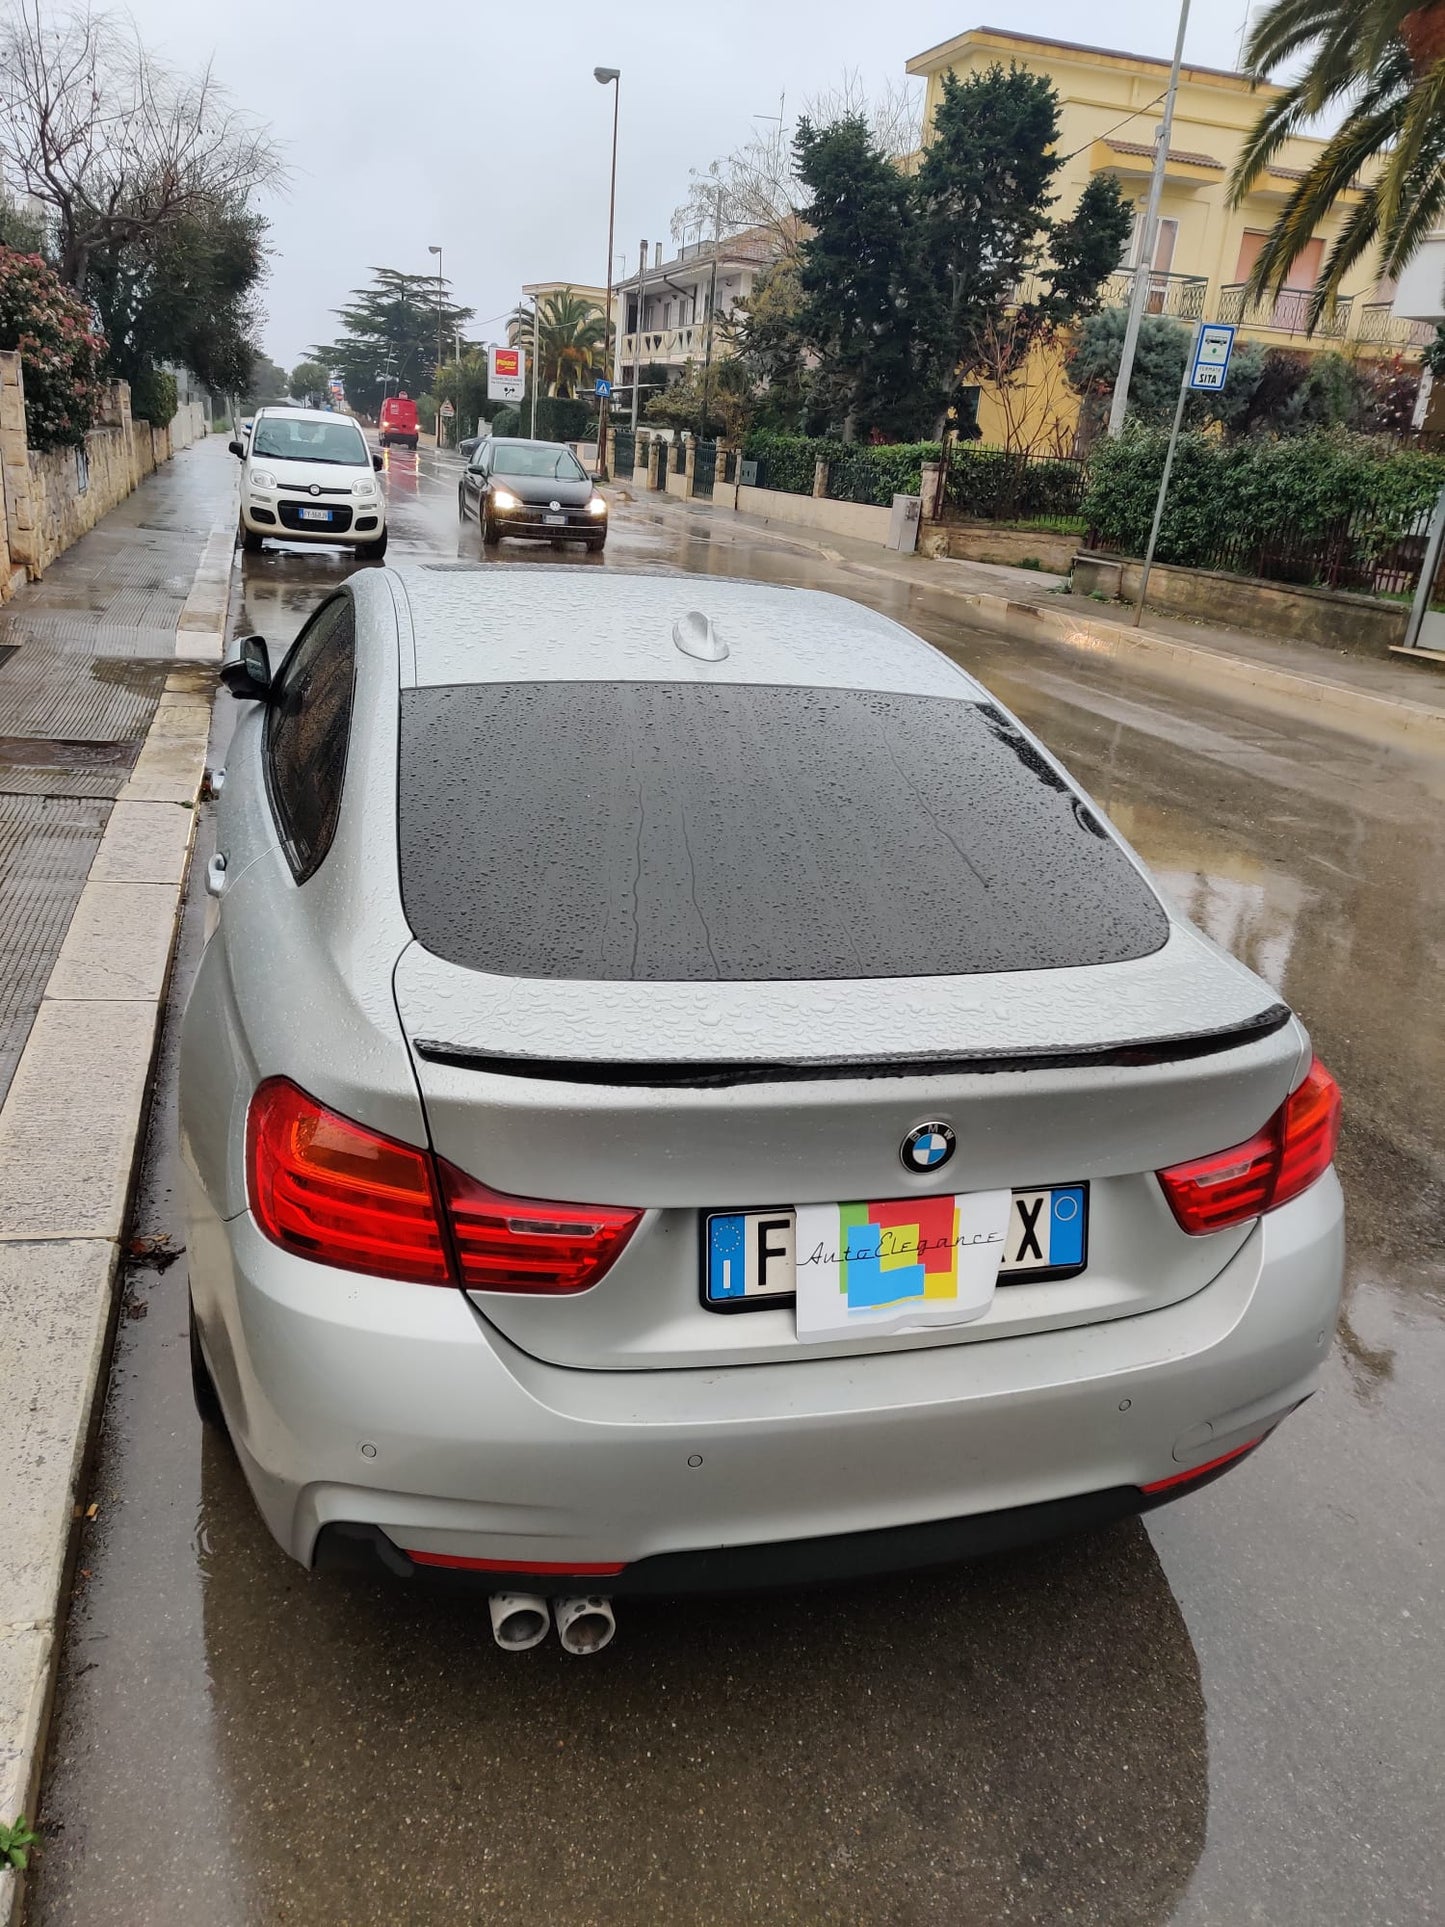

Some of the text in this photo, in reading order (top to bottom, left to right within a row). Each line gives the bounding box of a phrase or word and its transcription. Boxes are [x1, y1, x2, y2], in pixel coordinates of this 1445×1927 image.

[1199, 373, 1217, 384] SITA
[909, 1124, 954, 1142] BMW
[1000, 1197, 1044, 1267] X
[796, 1231, 1005, 1266] AutoElegance
